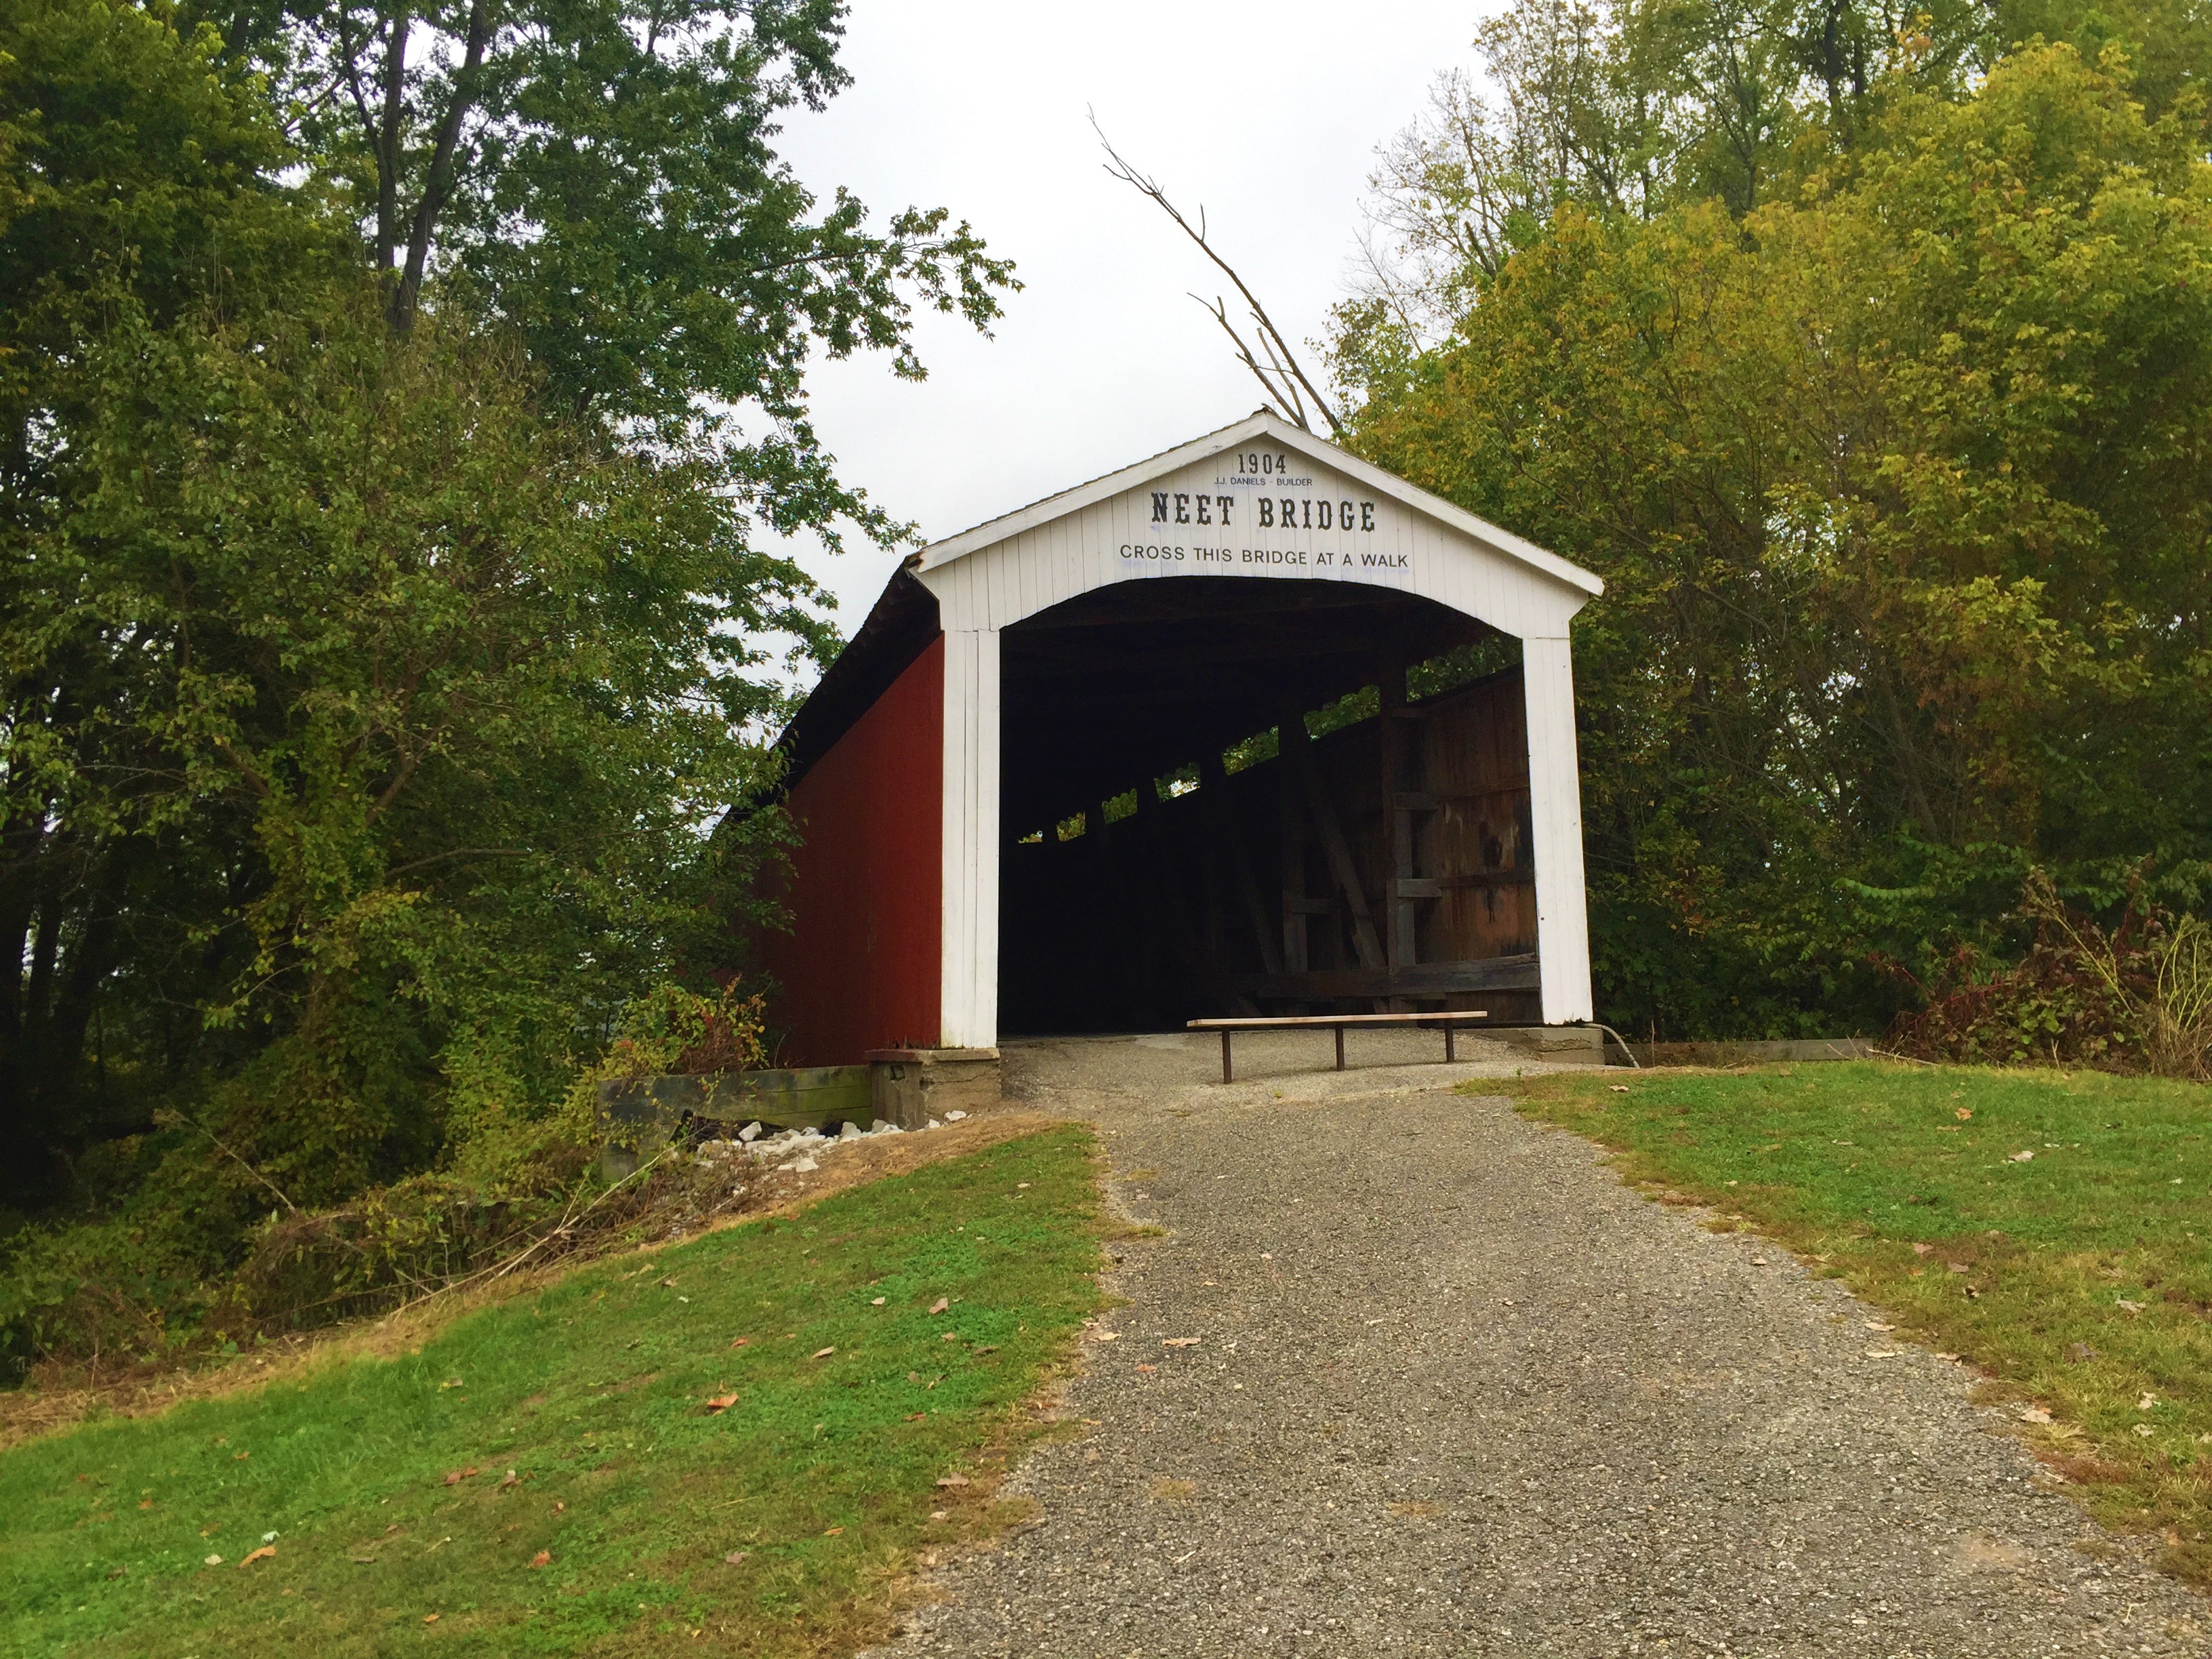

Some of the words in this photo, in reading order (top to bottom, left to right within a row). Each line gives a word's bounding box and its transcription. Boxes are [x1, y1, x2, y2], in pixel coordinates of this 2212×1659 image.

[1237, 453, 1286, 474] 1904
[1230, 478, 1266, 486] DANIELS
[1277, 478, 1313, 487] BUILDER
[1151, 492, 1234, 526] NEET
[1258, 497, 1375, 533] BRIDGE
[1120, 544, 1185, 561] CROSS
[1193, 548, 1232, 562] THIS
[1242, 550, 1307, 565] BRIDGE
[1316, 552, 1334, 565] AT
[1343, 553, 1353, 566] A
[1361, 553, 1408, 568] WALK
